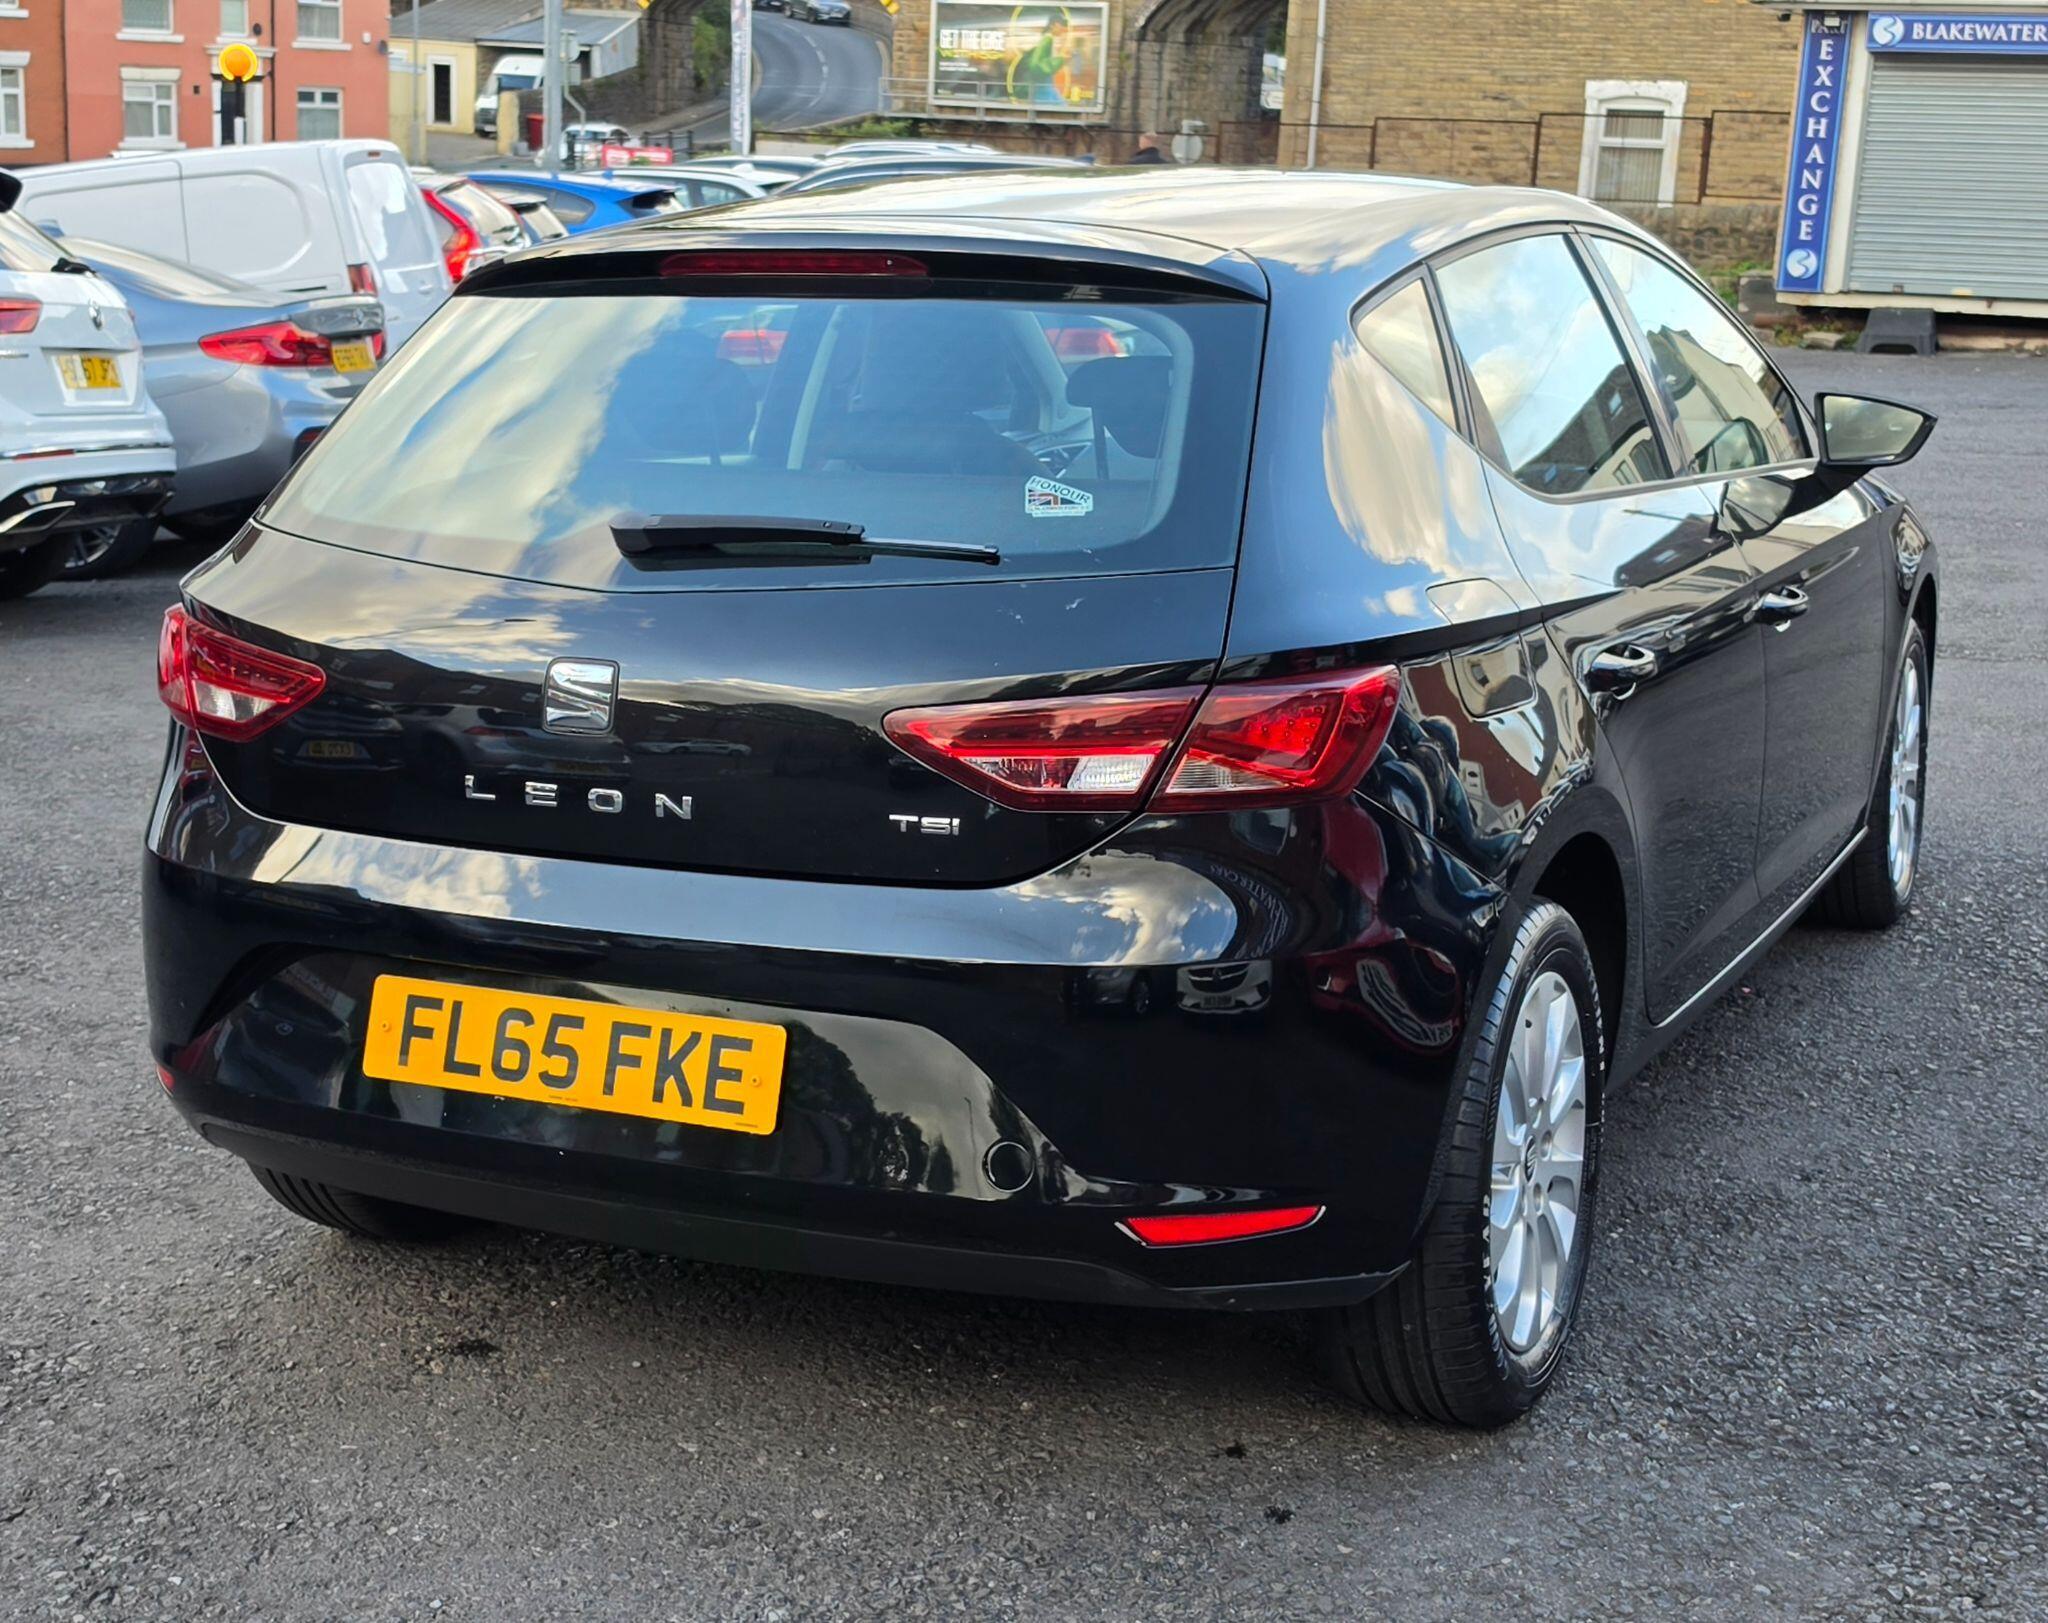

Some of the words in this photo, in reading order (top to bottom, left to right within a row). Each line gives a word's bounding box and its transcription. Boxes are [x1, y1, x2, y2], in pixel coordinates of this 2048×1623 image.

[1912, 22, 2048, 42] BLAKEWATER
[1798, 39, 1834, 241] EXCHANGE
[1029, 477, 1090, 504] HONOUR
[464, 774, 693, 820] LEON
[888, 814, 960, 836] TSI
[398, 993, 586, 1090] FL65
[602, 1020, 754, 1115] FKE
